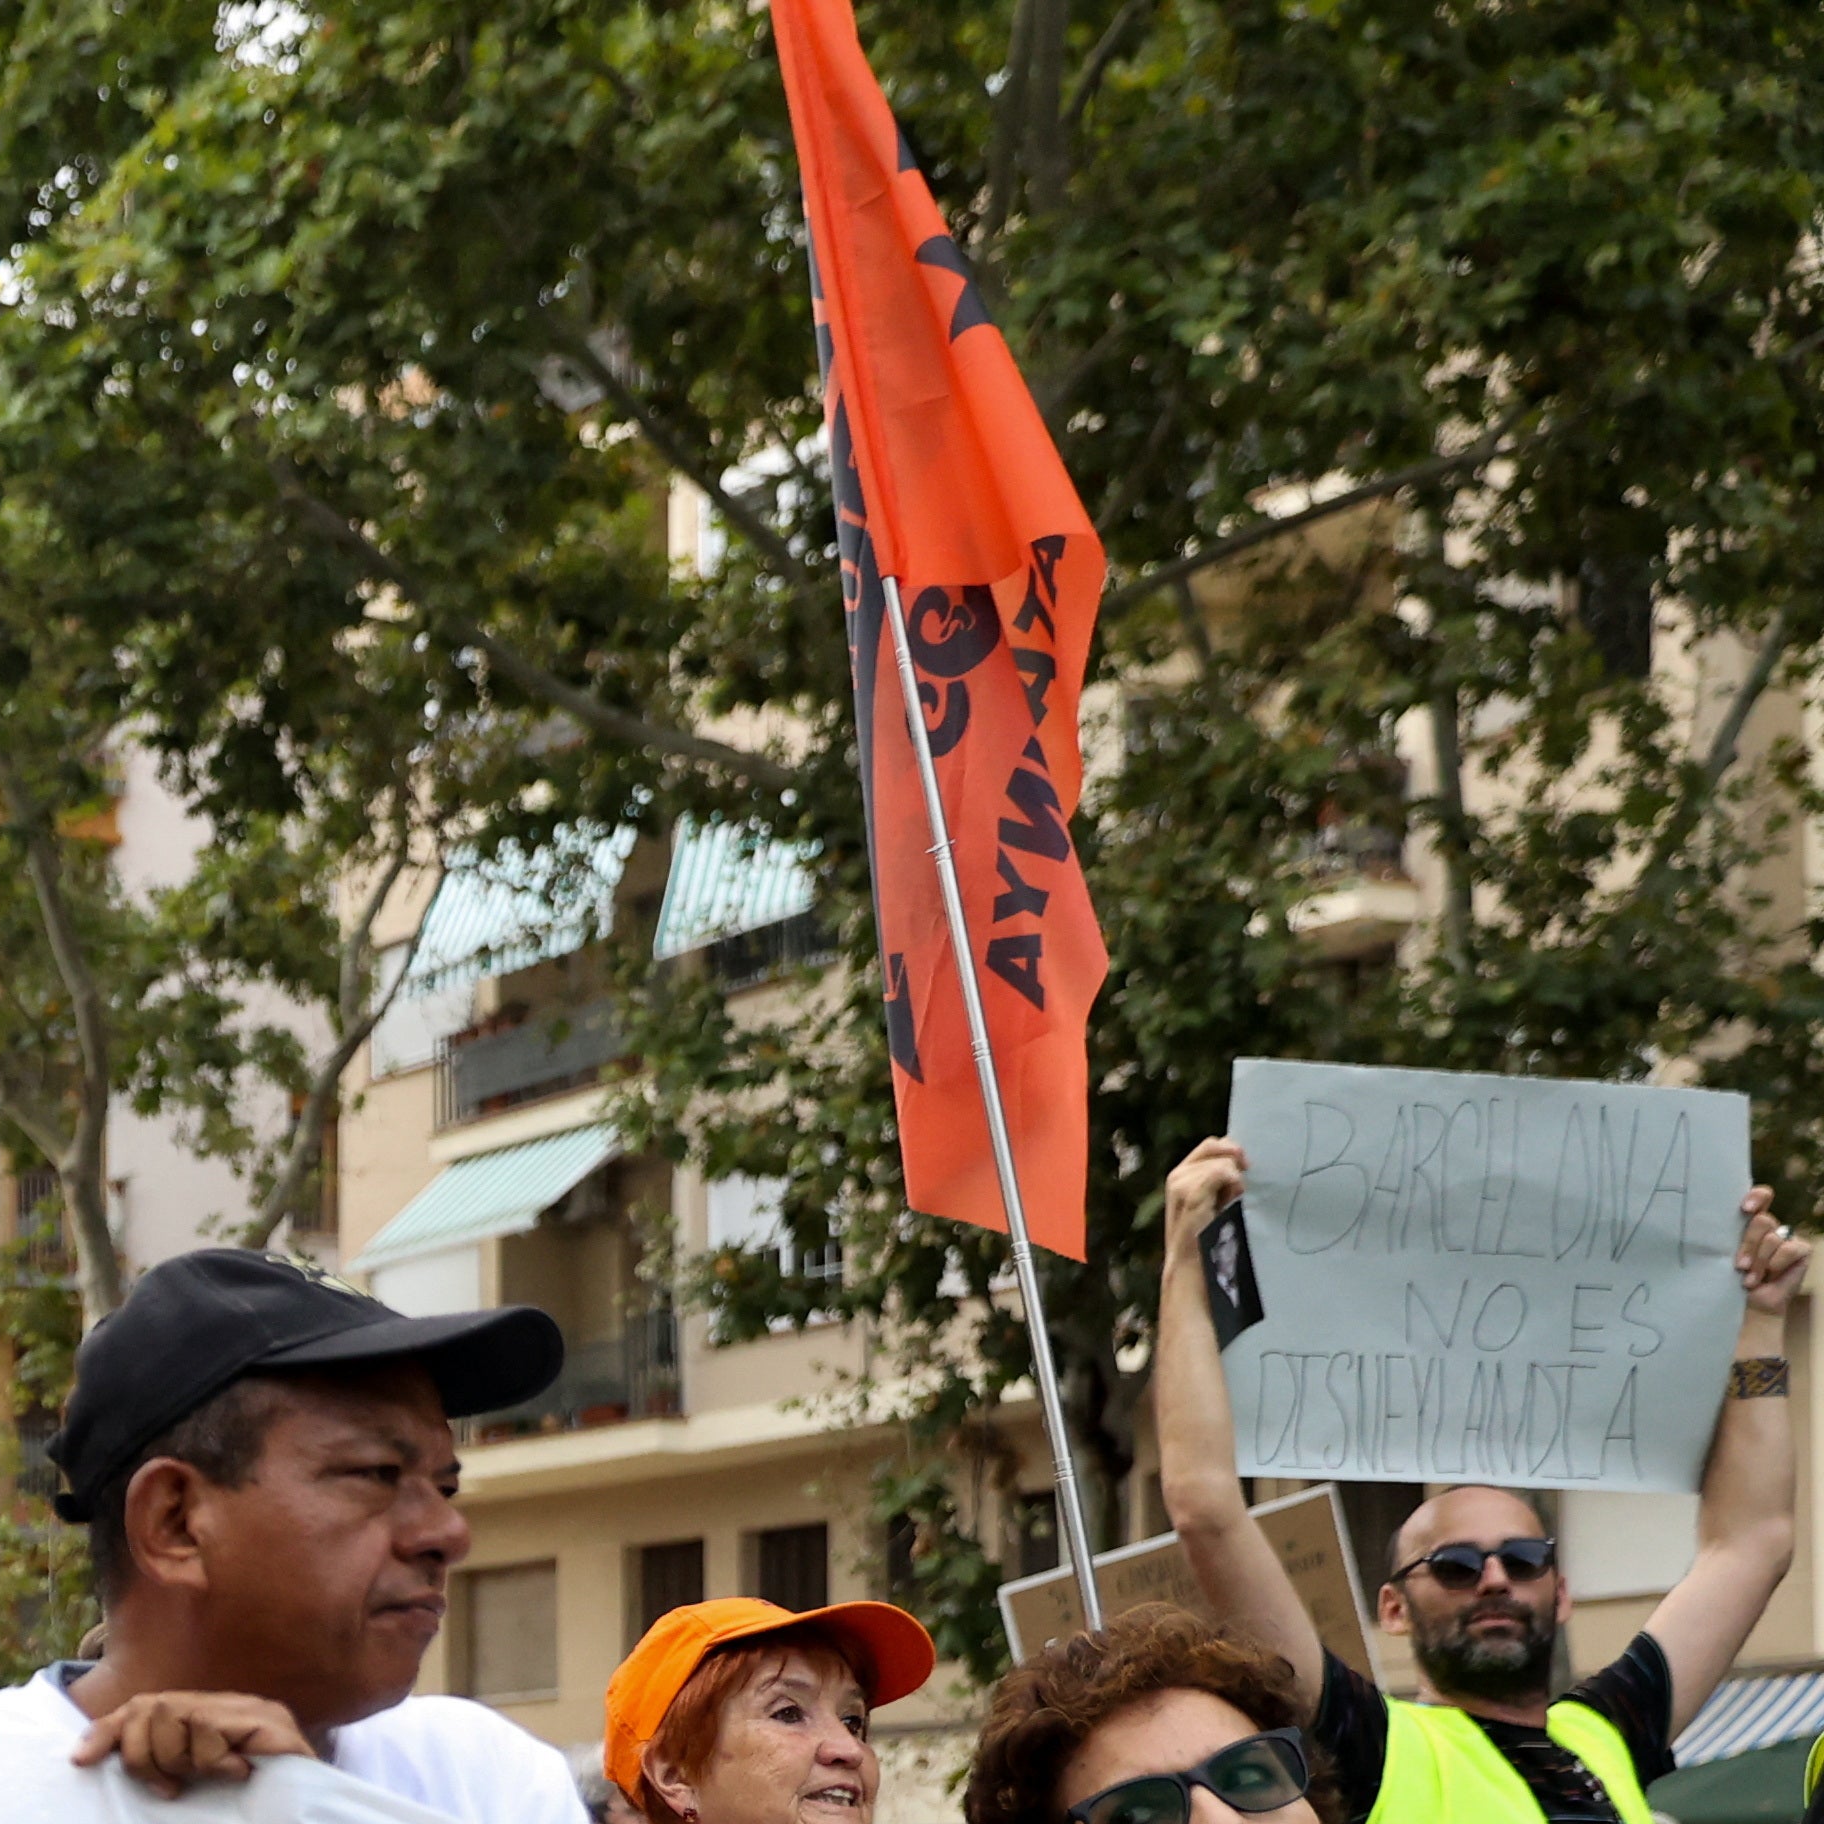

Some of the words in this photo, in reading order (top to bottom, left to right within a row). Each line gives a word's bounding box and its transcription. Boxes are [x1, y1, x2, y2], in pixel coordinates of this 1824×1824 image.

[1285, 1097, 1692, 1269] BARCELONA
[1405, 1279, 1527, 1351] NO
[1571, 1282, 1665, 1358] ES
[1254, 1351, 1642, 1481] DISNEYLANDIA
